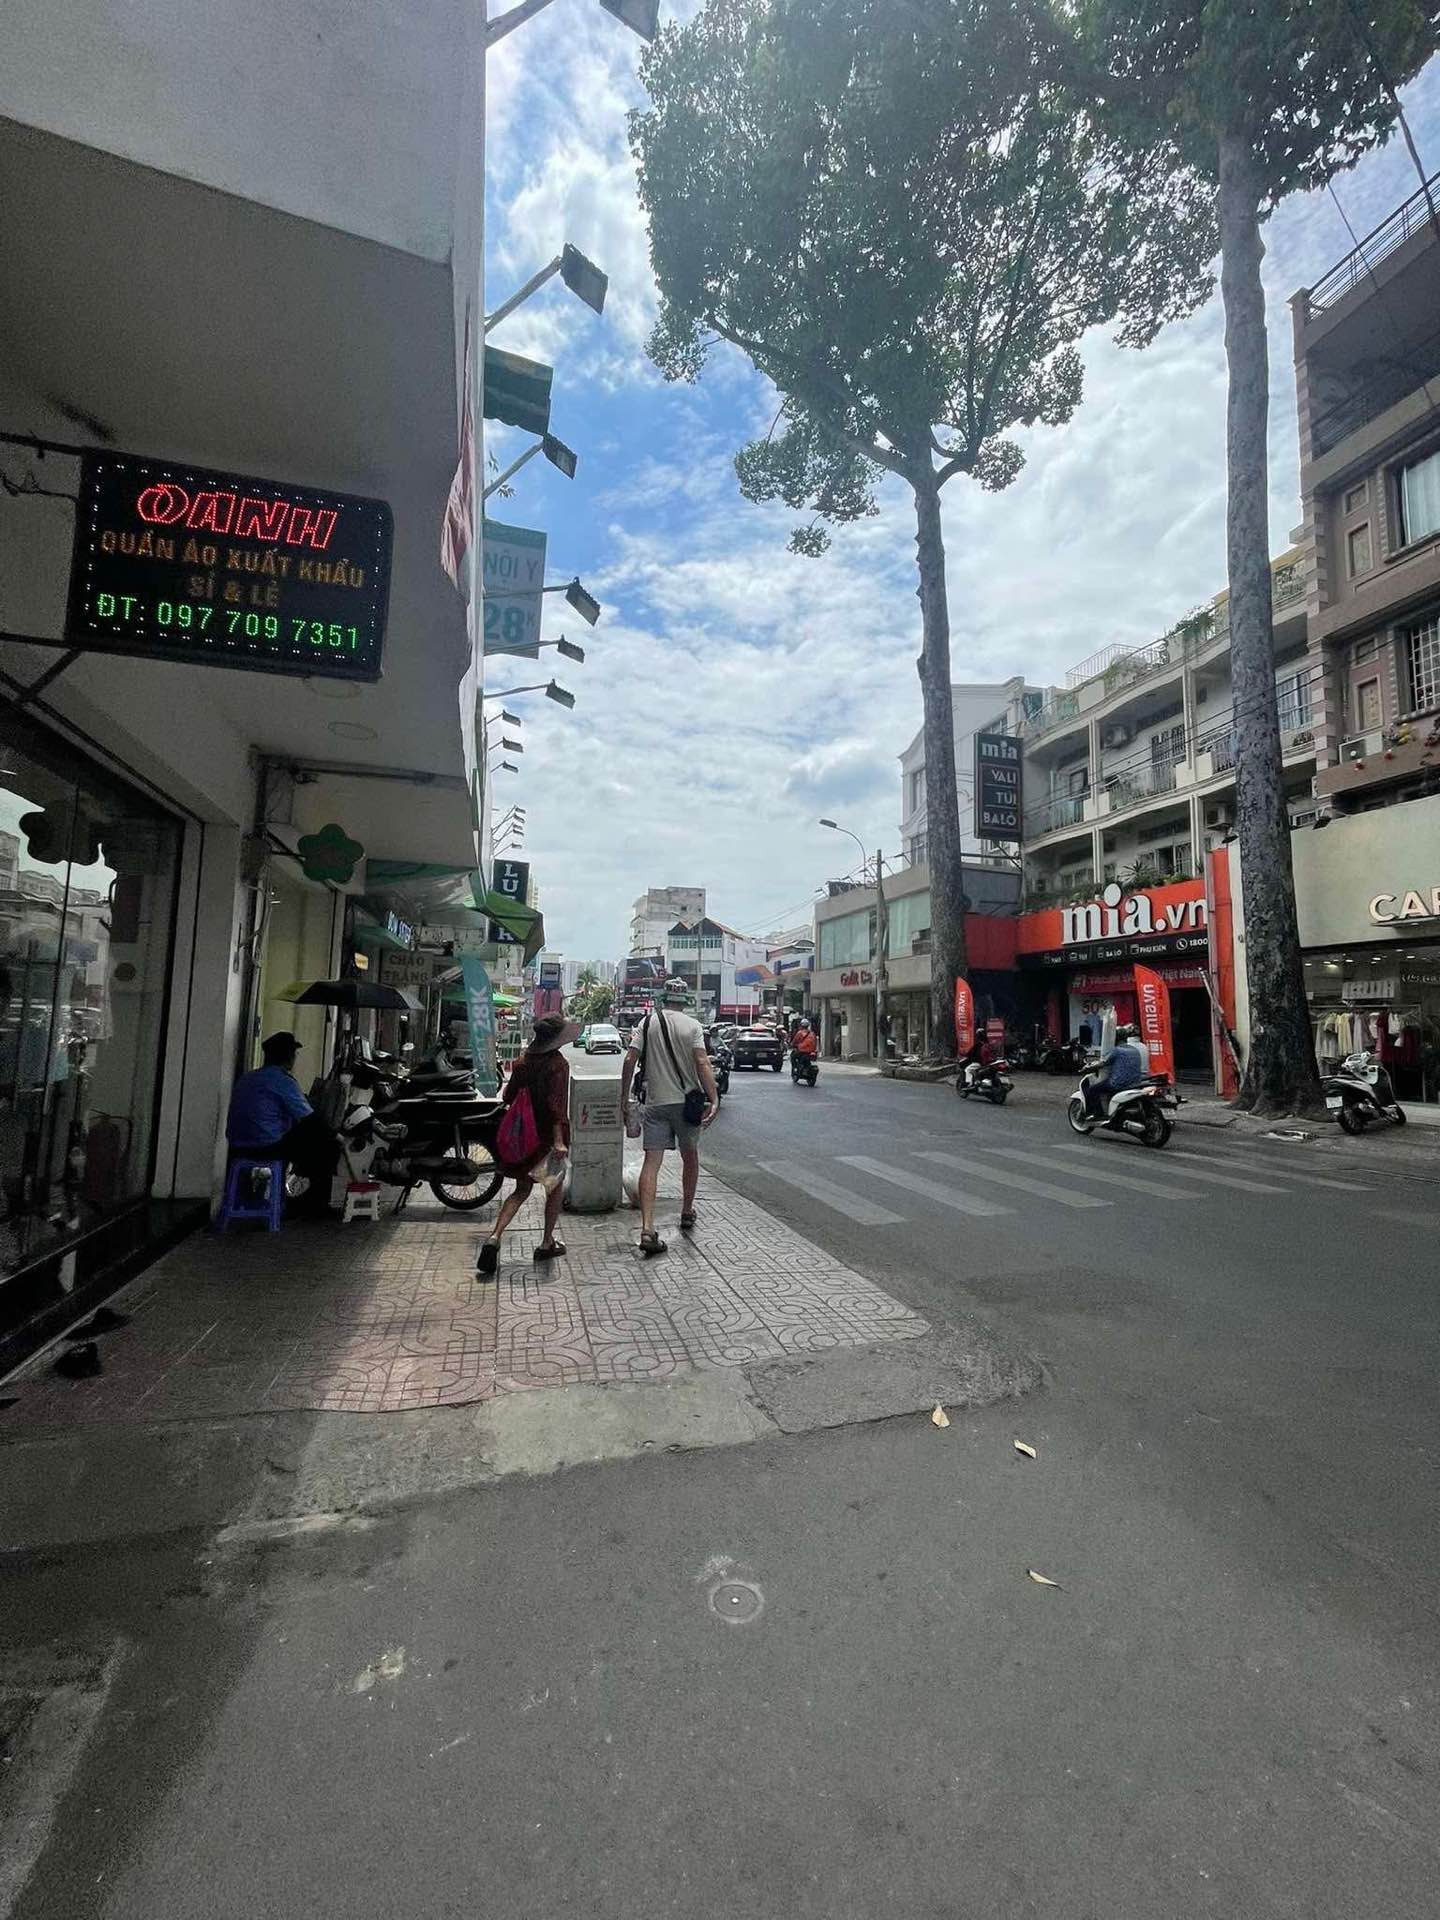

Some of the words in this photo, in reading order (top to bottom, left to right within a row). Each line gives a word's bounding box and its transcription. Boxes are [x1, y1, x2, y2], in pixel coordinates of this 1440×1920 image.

[526, 558, 539, 582] Y
[97, 592, 145, 622] ĐT:
[158, 601, 213, 630] 097
[227, 609, 278, 640] 709
[292, 618, 358, 649] 7351
[982, 740, 1018, 760] mia
[991, 768, 1017, 785] VALI
[1061, 883, 1207, 945] mia.vn
